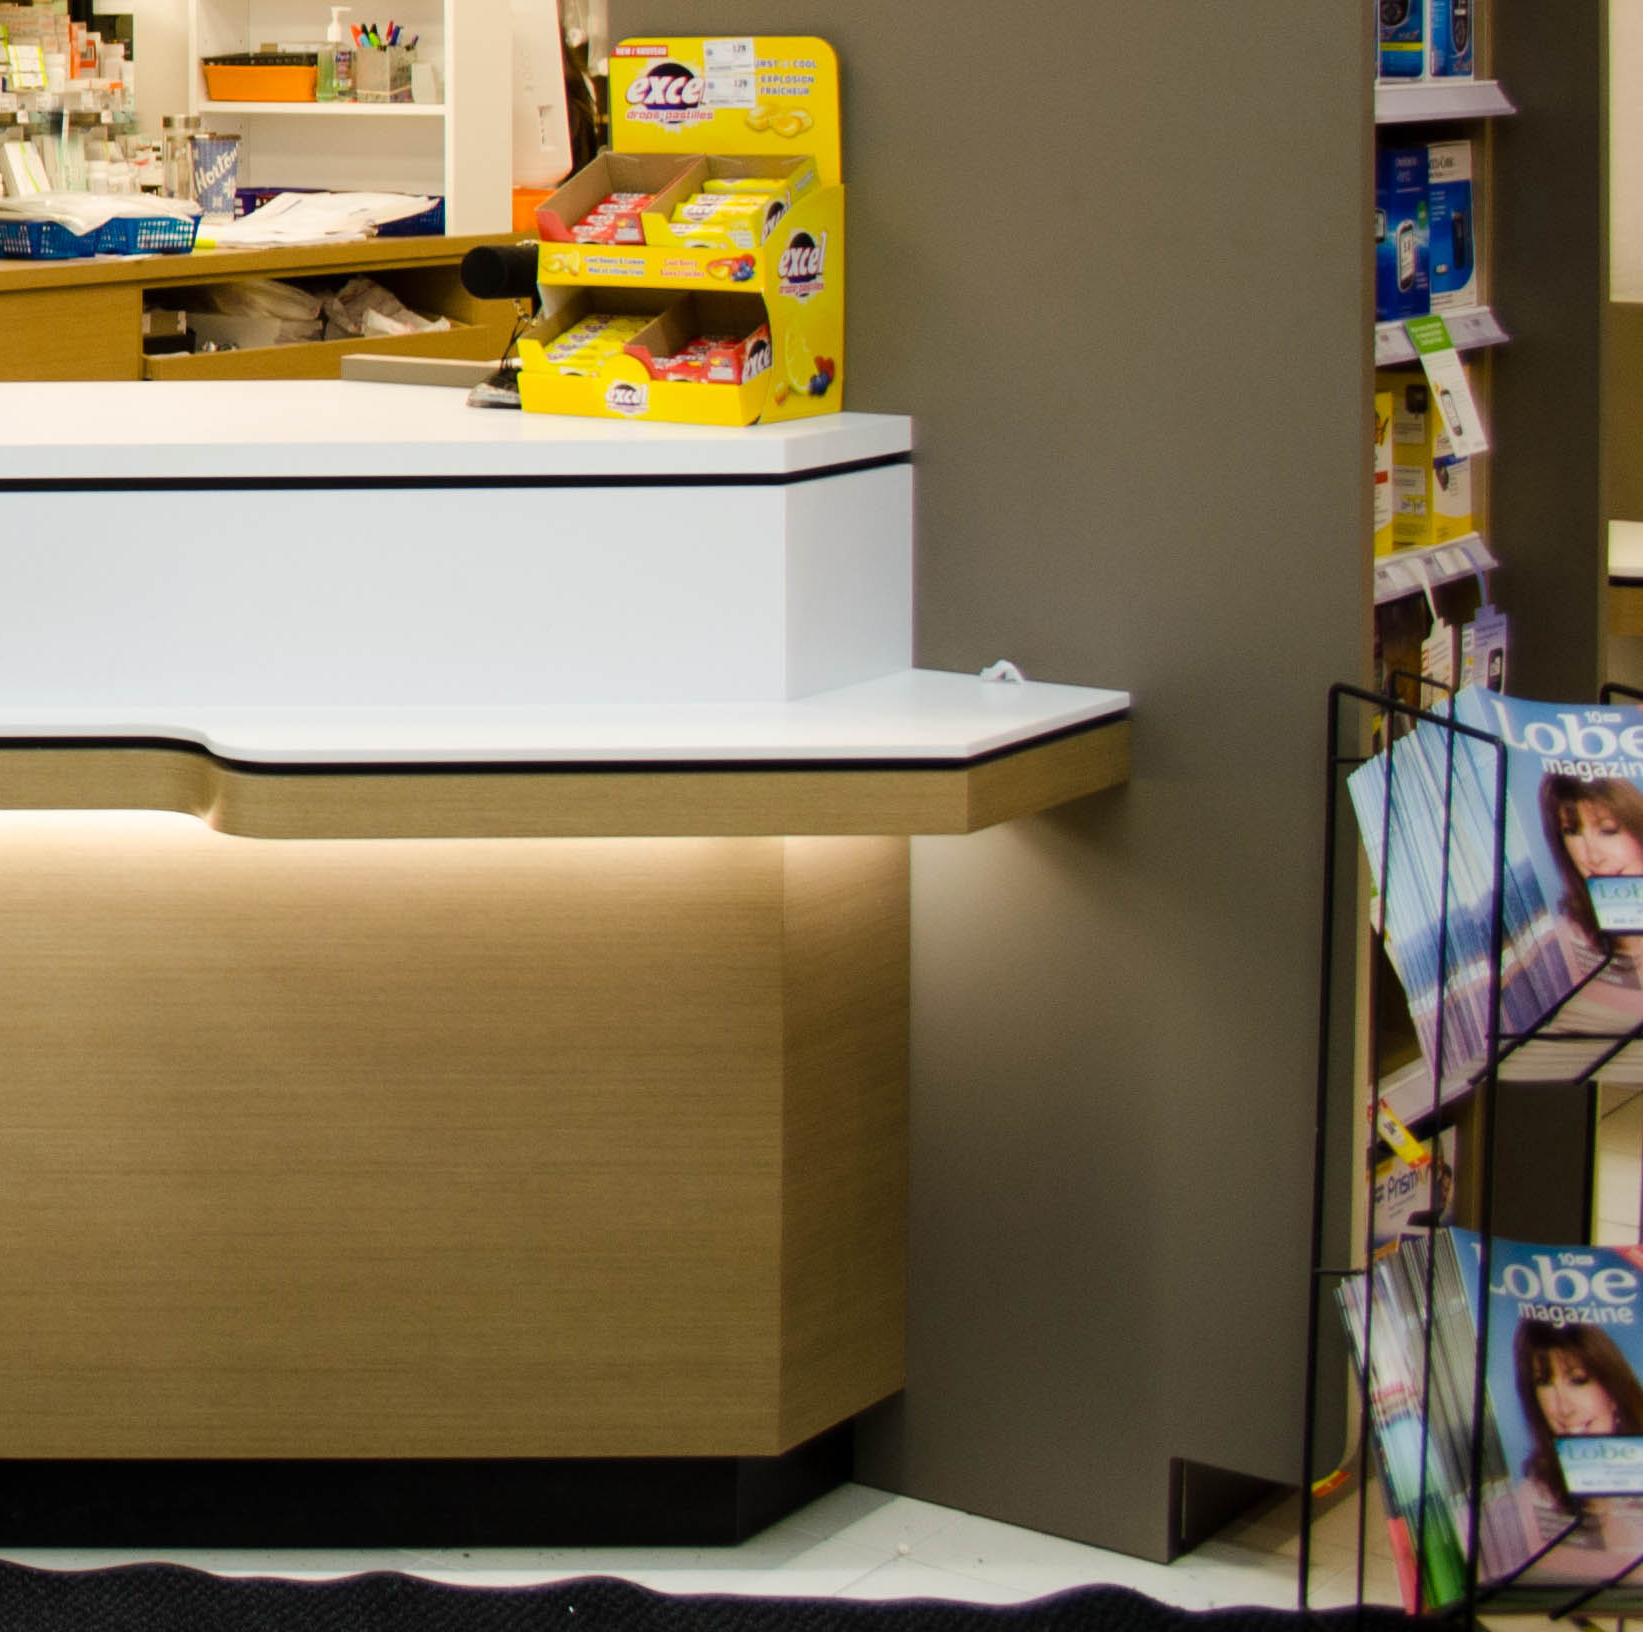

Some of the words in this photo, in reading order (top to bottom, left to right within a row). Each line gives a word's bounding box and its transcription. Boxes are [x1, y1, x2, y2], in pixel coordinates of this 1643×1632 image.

[778, 232, 827, 278] excel
[604, 382, 647, 404] excel
[1491, 698, 1643, 760] Lobe
[1541, 754, 1643, 782] magazin
[1518, 1300, 1634, 1329] magazine
